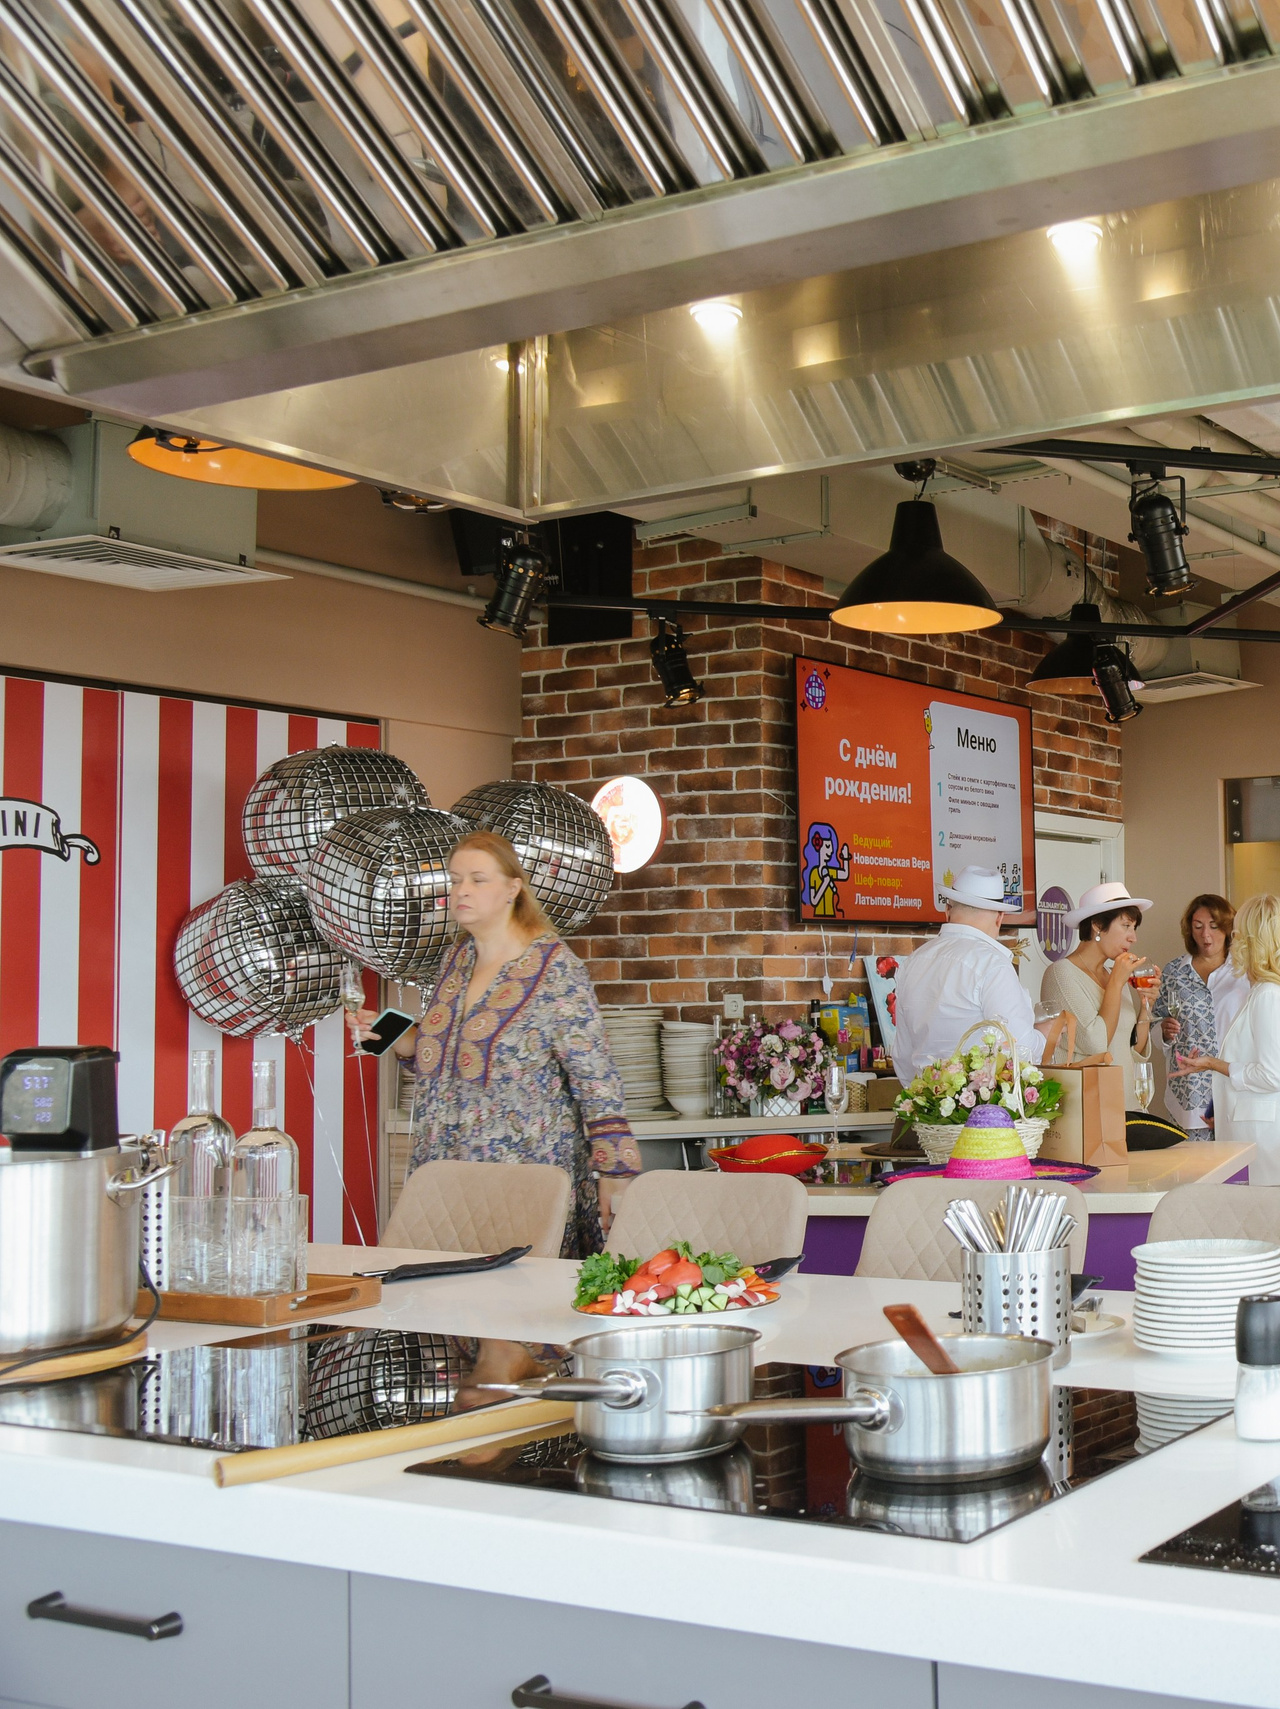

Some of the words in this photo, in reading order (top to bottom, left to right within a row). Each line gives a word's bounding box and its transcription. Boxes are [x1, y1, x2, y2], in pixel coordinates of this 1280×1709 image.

[957, 726, 997, 753] Меню
[839, 738, 851, 762] С
[855, 744, 897, 769] днём
[824, 776, 911, 805] рождения!
[937, 781, 942, 797] 1
[853, 833, 893, 850] Ведущий:
[938, 830, 945, 847] 2
[853, 852, 911, 868] Новосельская
[911, 856, 931, 871] Вера
[854, 873, 903, 890] Шеф-повар:
[854, 892, 892, 907] Латыпов
[893, 894, 922, 910] Данияр
